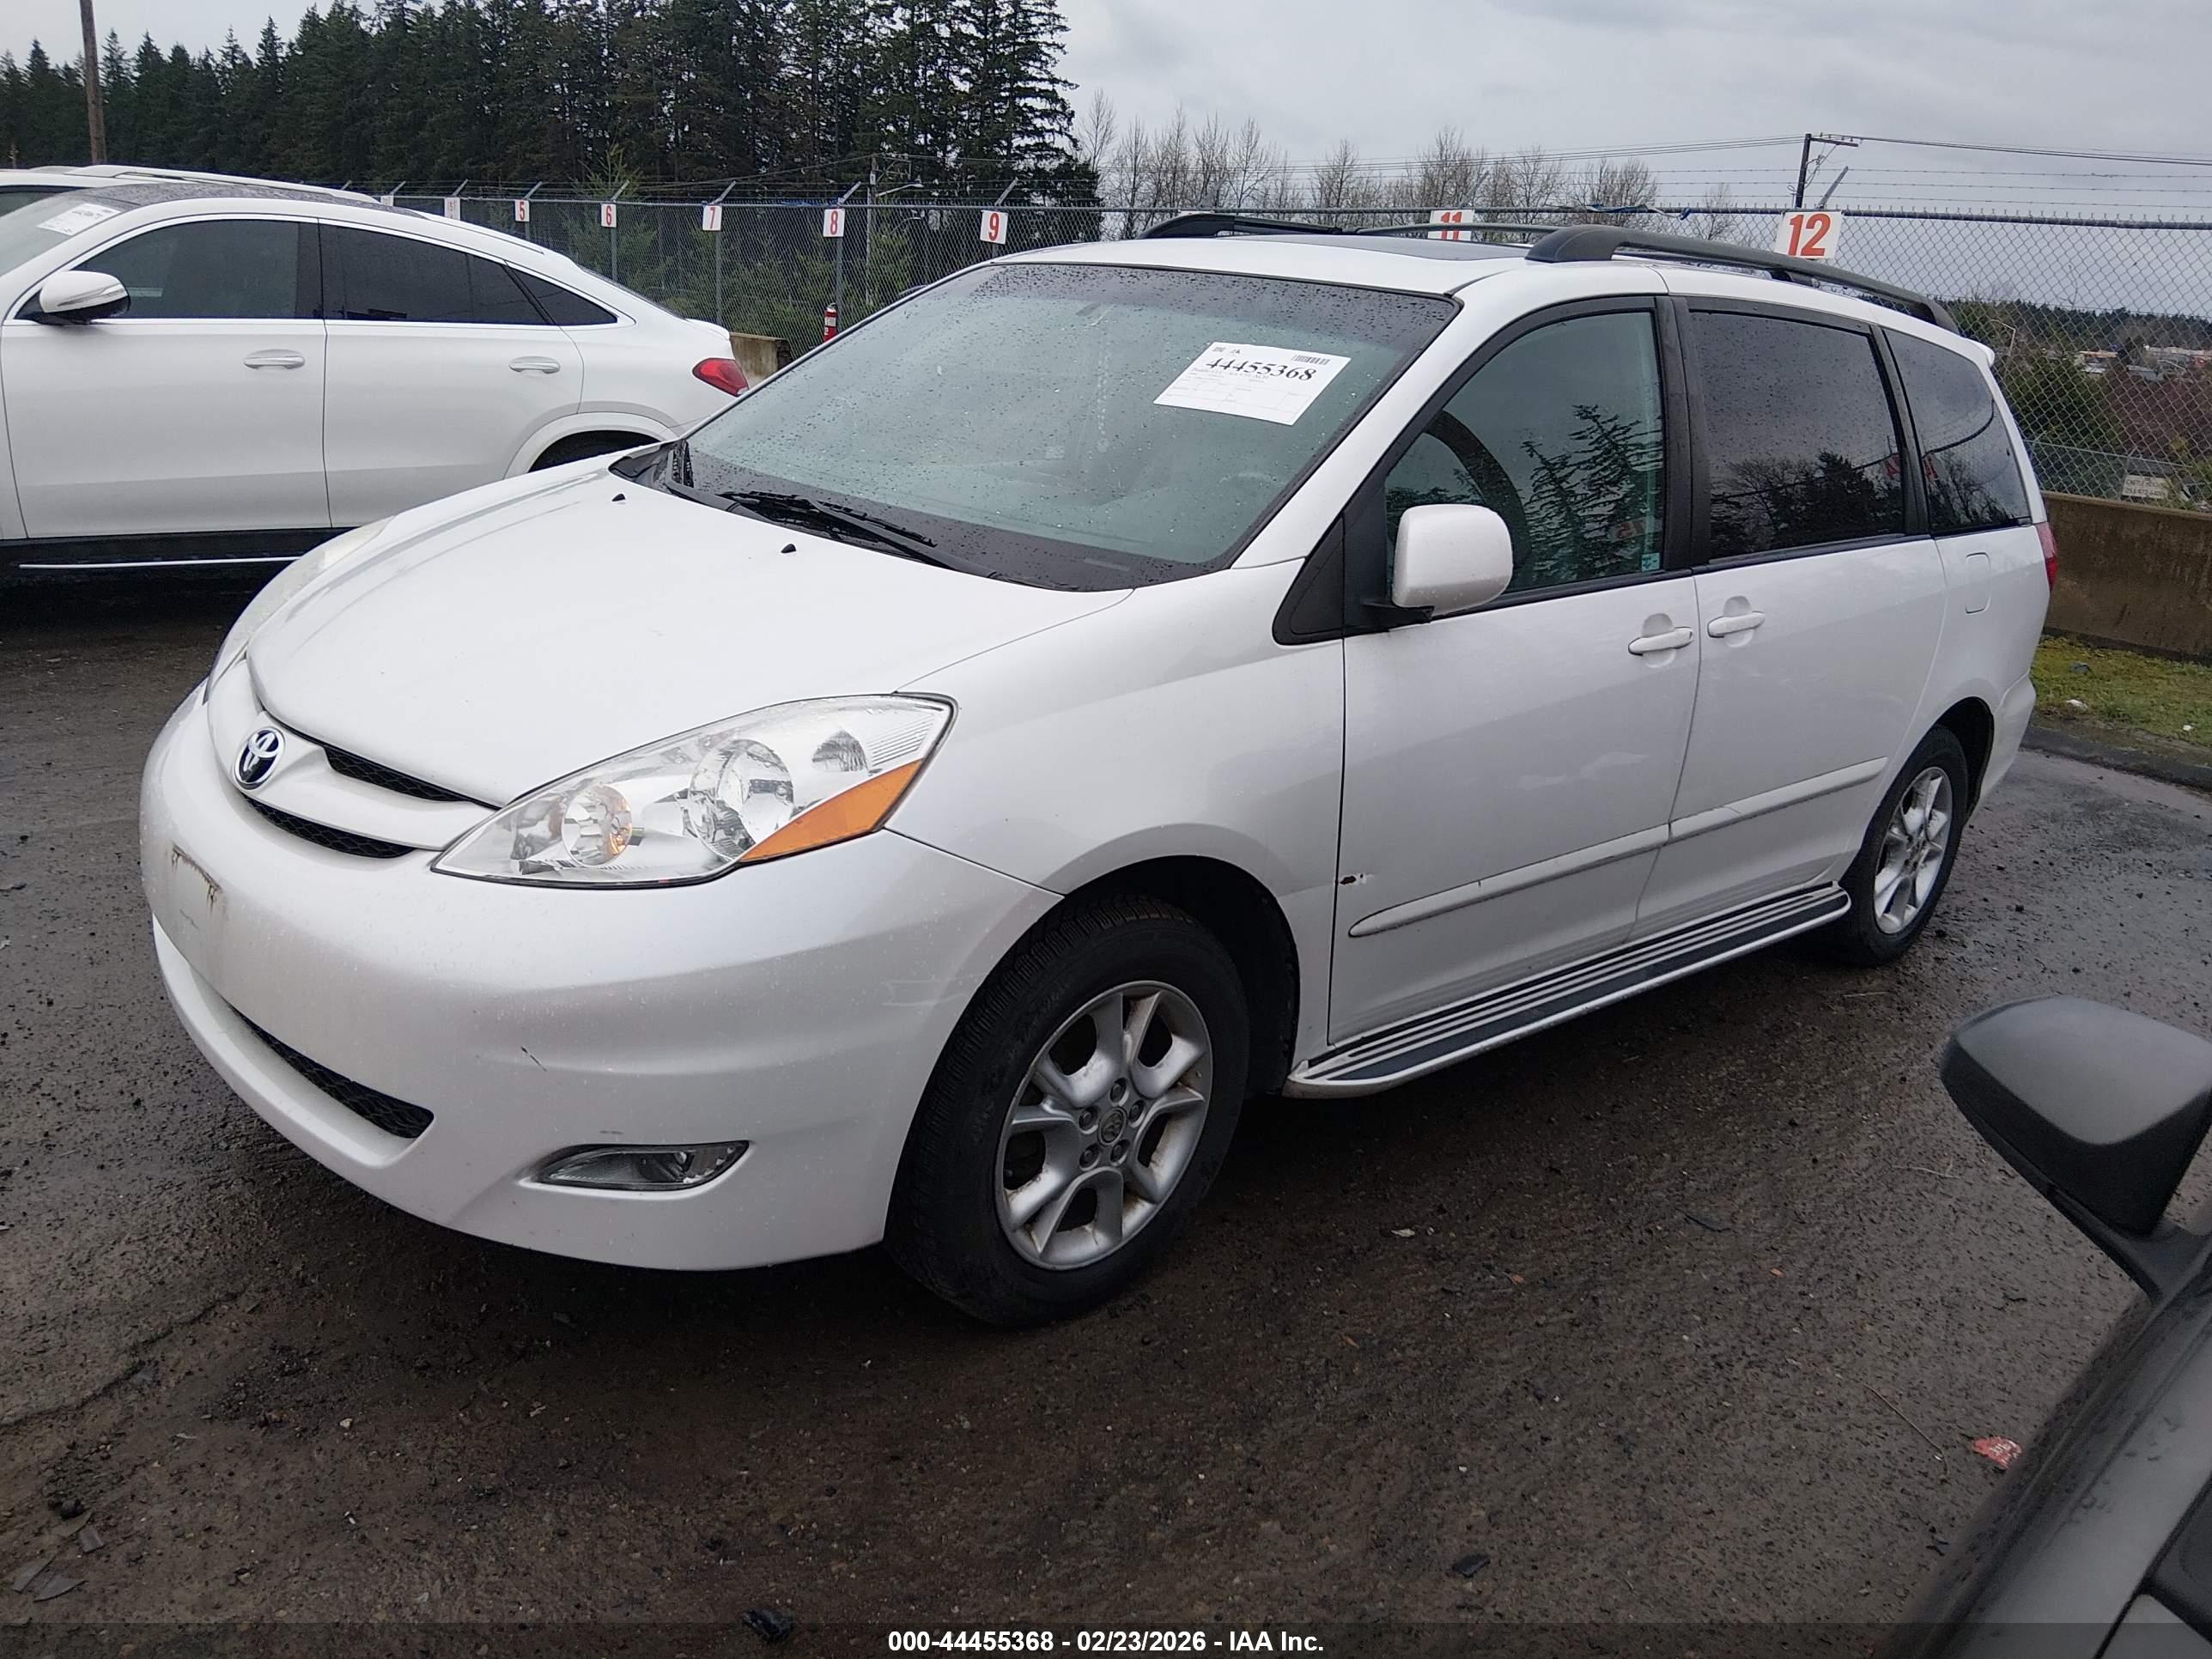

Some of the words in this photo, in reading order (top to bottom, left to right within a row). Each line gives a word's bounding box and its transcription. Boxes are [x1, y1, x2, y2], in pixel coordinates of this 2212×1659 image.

[519, 201, 526, 221] 5
[605, 205, 613, 226] 6
[709, 206, 717, 230] 7
[830, 210, 839, 235] 8
[988, 212, 1000, 242] 9
[1440, 211, 1463, 241] 11
[1788, 213, 1832, 258] 12
[1206, 357, 1317, 380] 44455368
